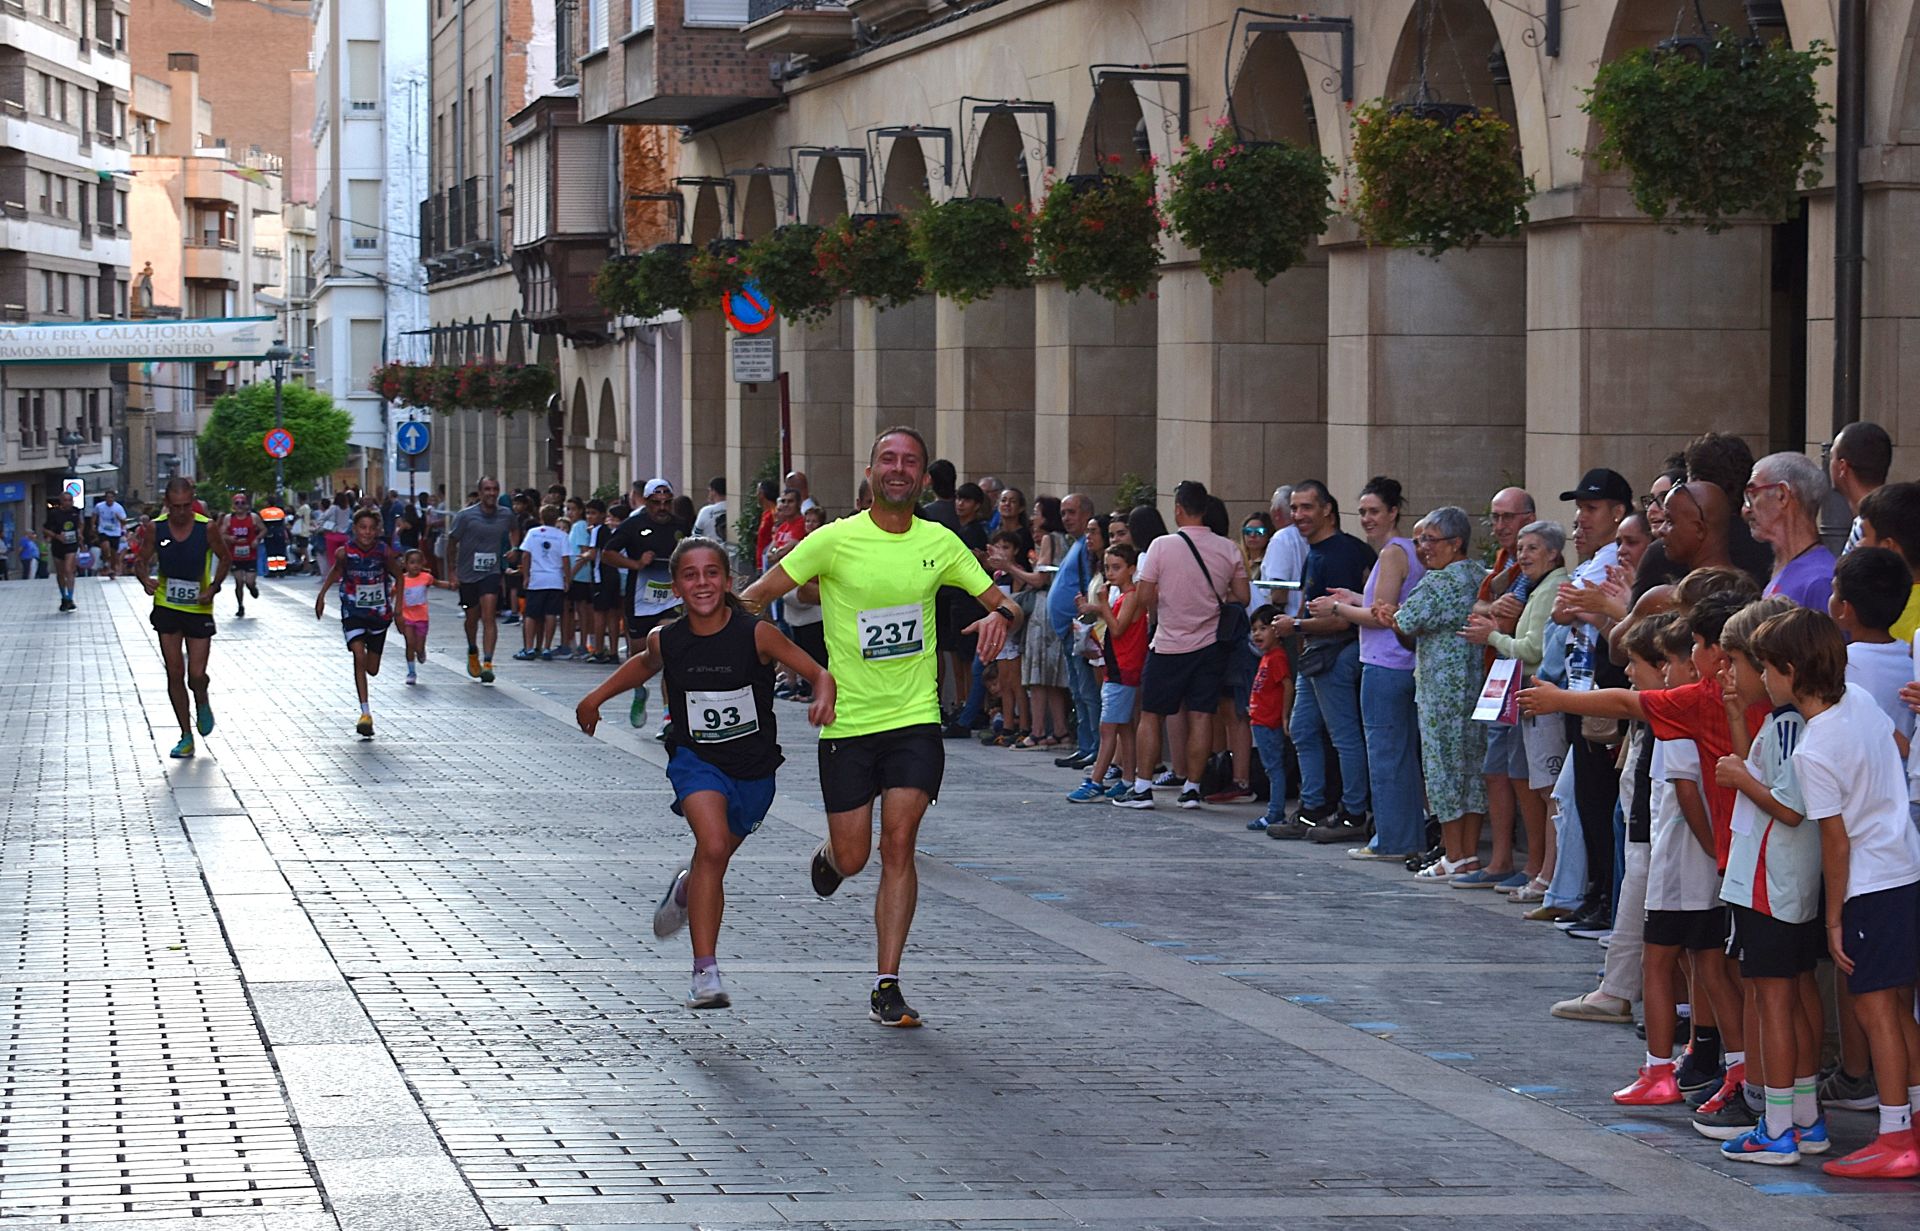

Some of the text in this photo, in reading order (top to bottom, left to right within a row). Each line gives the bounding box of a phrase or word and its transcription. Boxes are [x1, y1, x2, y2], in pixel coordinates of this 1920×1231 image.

[52, 329, 87, 341] ERES
[96, 325, 215, 340] CALAHORRA
[57, 345, 82, 356] DEL
[89, 345, 149, 356] MUNDO
[155, 344, 214, 355] ENTERO
[170, 586, 196, 599] 185
[360, 591, 382, 601] 215
[865, 619, 917, 647] 237
[703, 706, 741, 729] 93
